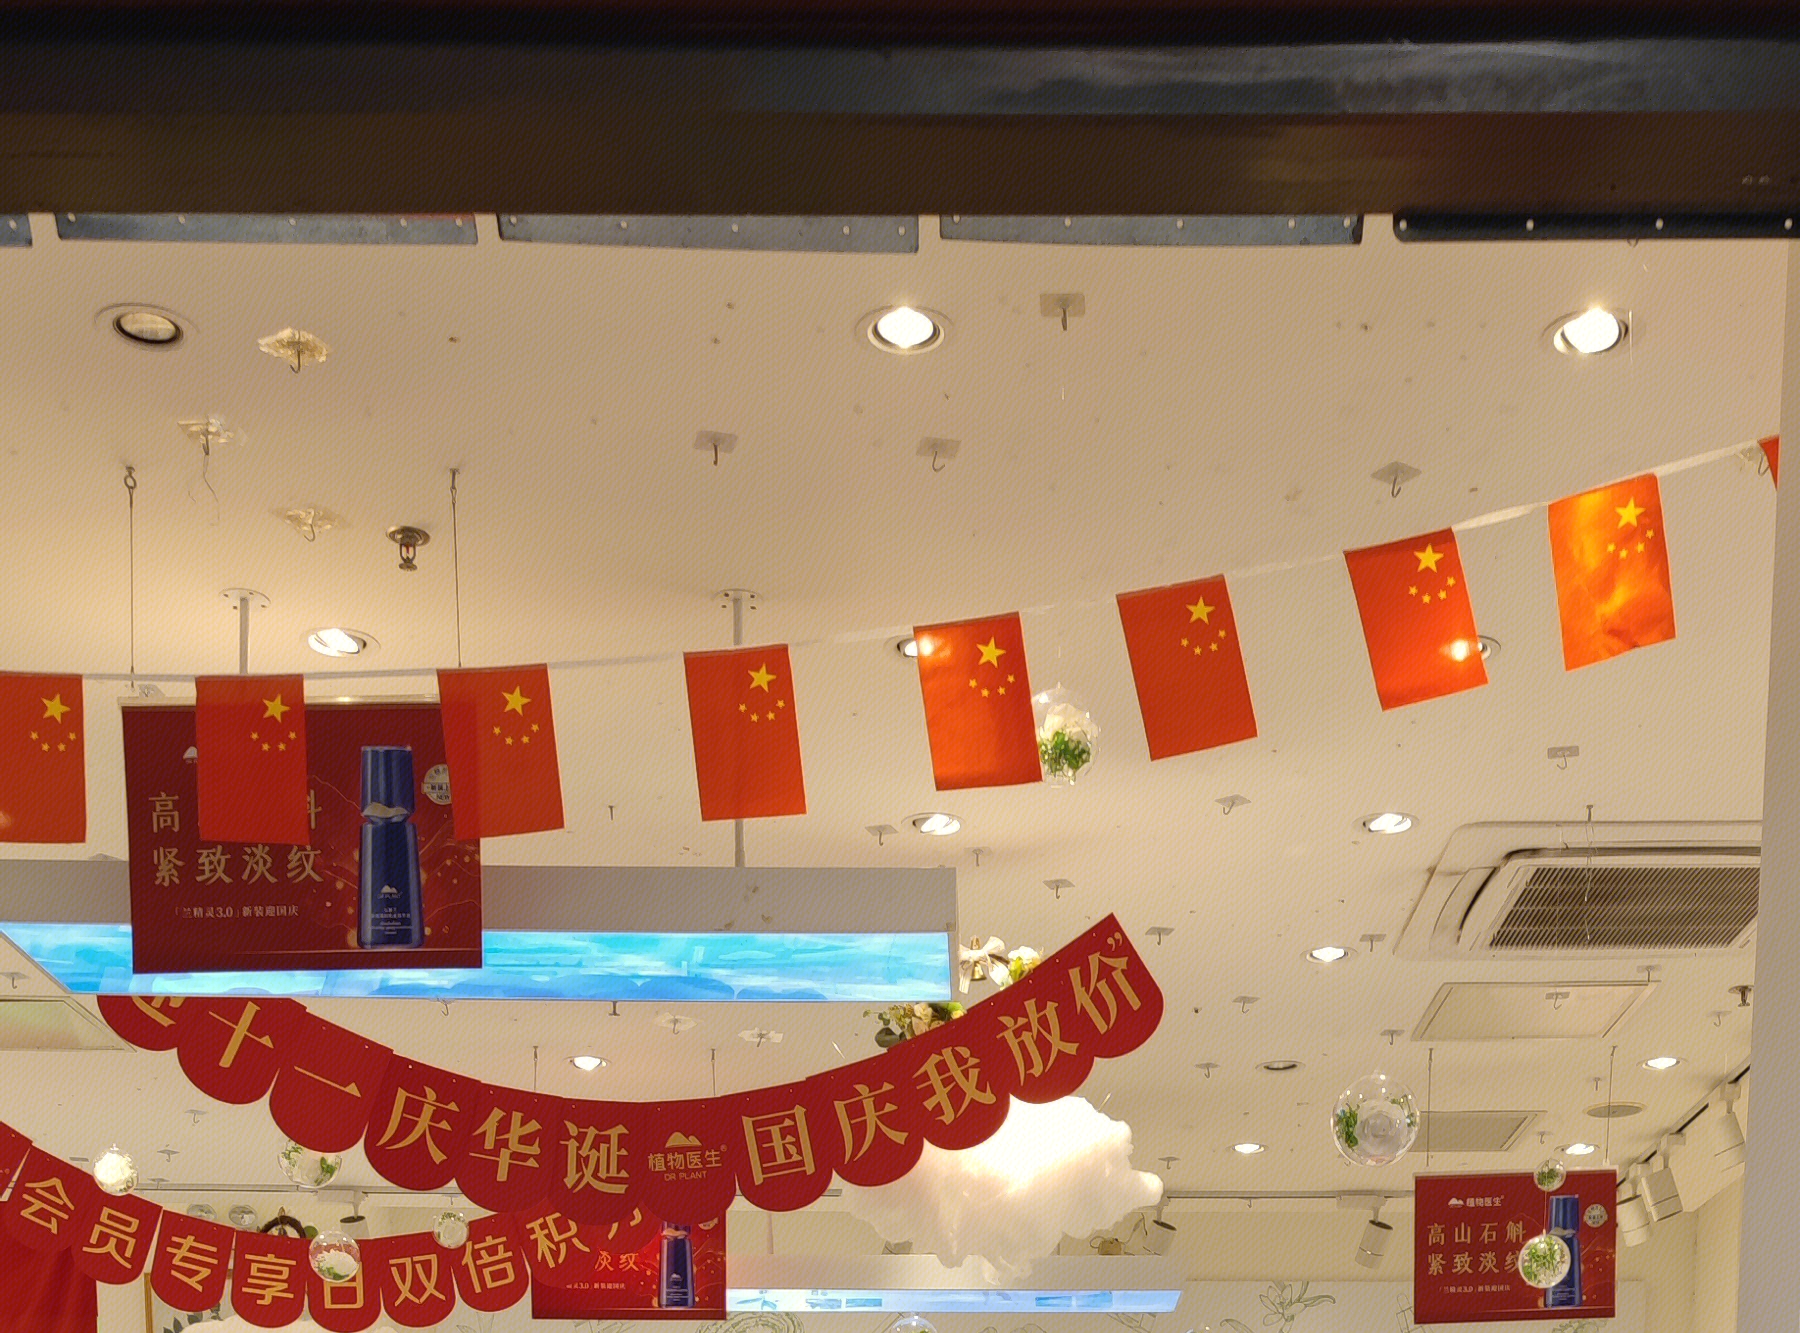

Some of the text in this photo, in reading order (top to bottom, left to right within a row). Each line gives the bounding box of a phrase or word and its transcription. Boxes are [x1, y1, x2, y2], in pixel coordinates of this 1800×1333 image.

[153, 844, 324, 887] 紧致淡纹
[648, 1149, 722, 1172] 植物医生
[664, 1170, 708, 1181] DR PLANT
[1466, 1197, 1502, 1208] 植物医生
[20, 1177, 643, 1310] 会员专享日双倍积
[1427, 1220, 1527, 1247] 高山石斛
